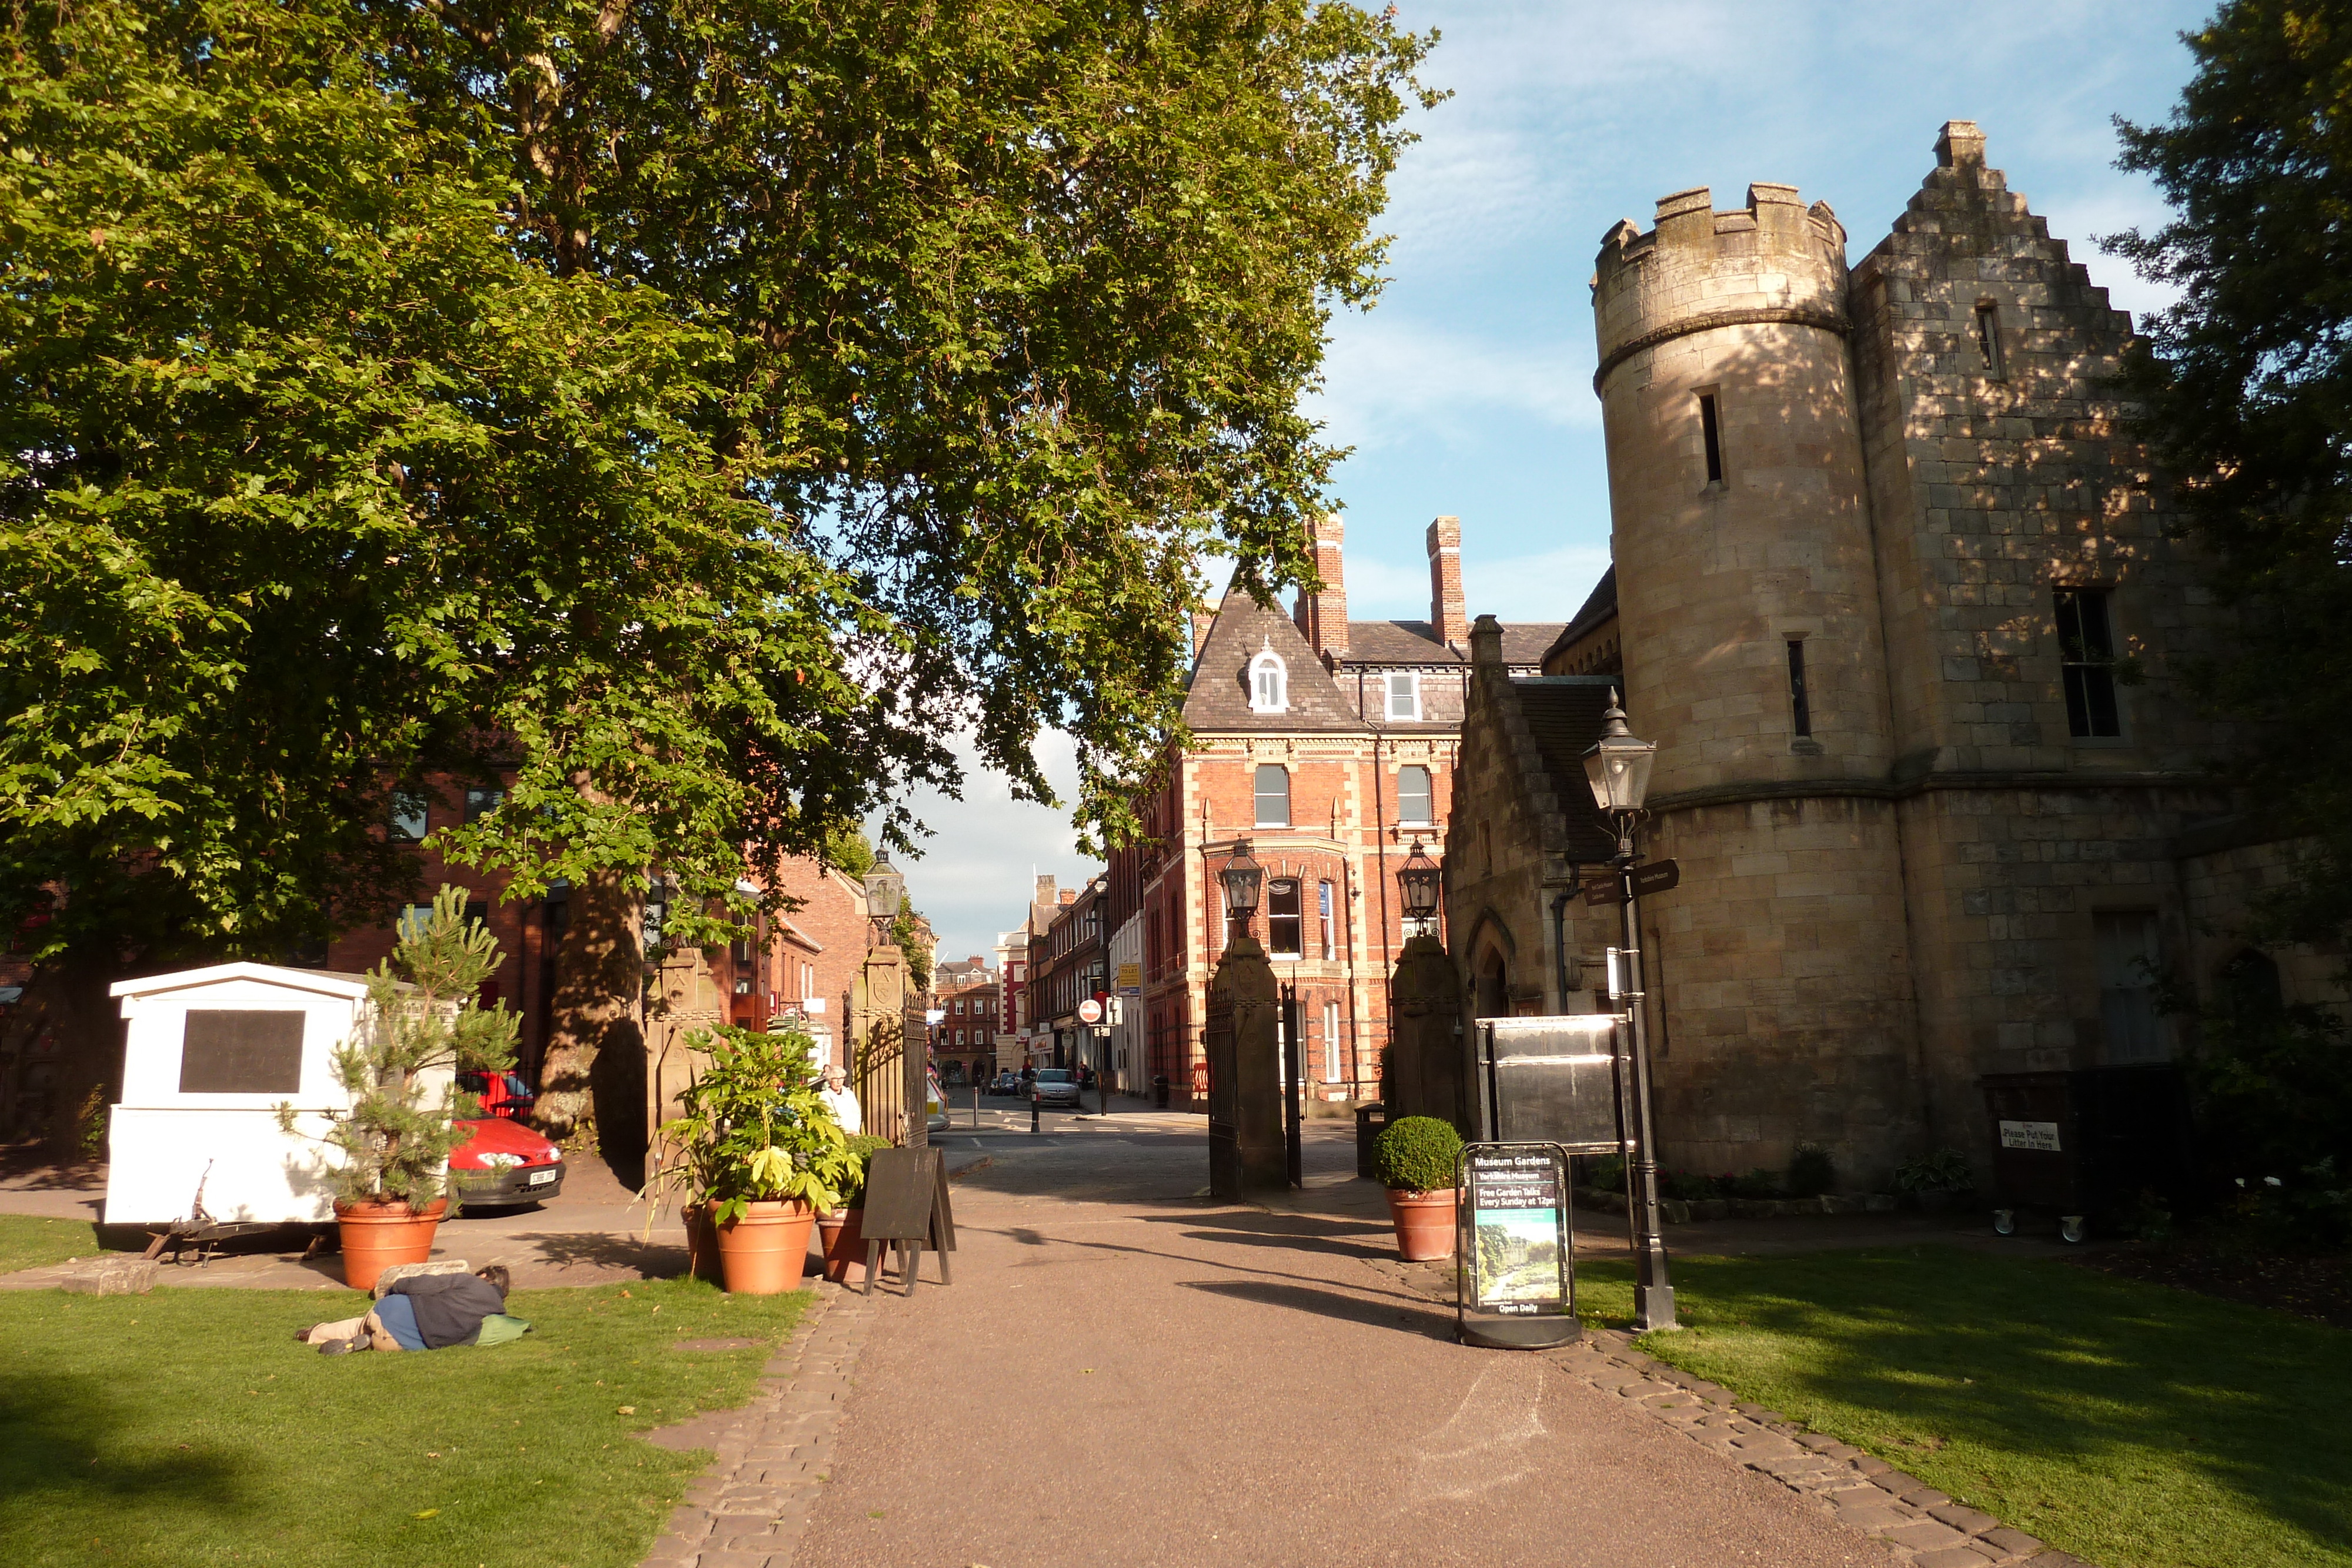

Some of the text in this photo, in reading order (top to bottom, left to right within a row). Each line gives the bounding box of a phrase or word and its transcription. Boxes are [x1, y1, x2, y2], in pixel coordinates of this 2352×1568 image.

[1640, 872, 1668, 884] Yorkshire Museum
[2004, 1128, 2055, 1141] Please Put Your
[2009, 1138, 2052, 1149] Litter In Here
[1475, 1156, 1551, 1166] Museum Gardens
[1479, 1172, 1511, 1180] Yorkshire
[1479, 1188, 1541, 1197] Free Garden Talks
[1479, 1198, 1499, 1208] Every
[1501, 1198, 1527, 1207] Sunday
[1499, 1303, 1538, 1313] Open Daily
